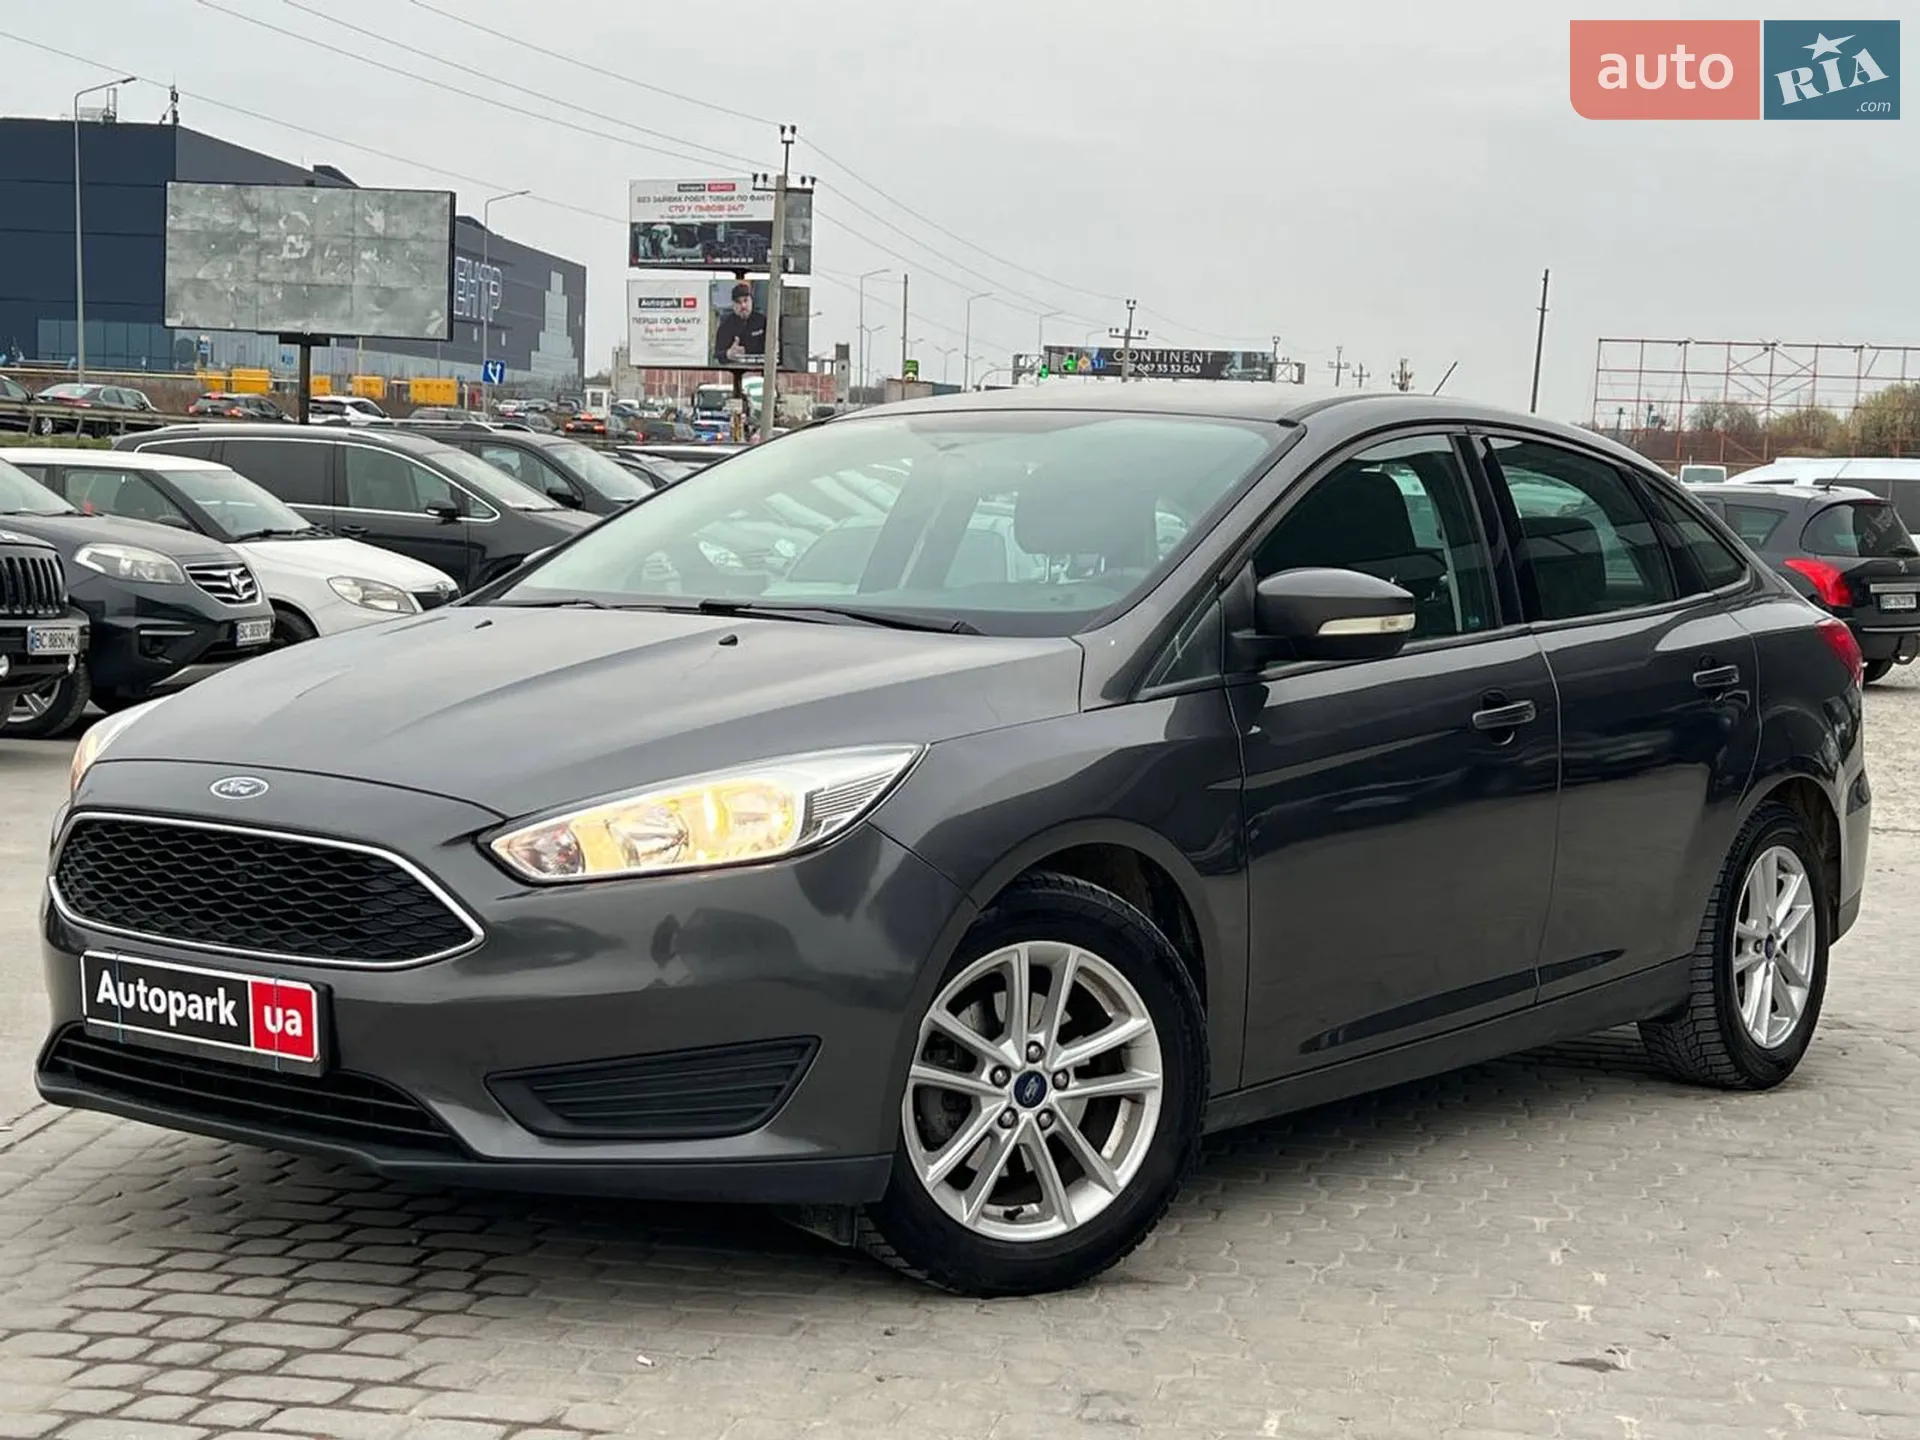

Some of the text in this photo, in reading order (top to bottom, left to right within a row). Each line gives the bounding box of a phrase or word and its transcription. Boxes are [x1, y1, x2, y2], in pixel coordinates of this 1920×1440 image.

[668, 204, 685, 212] СТО
[640, 299, 679, 307] Autopark
[1113, 349, 1212, 364] CONTINENT
[96, 969, 303, 1037] Autopark ua
